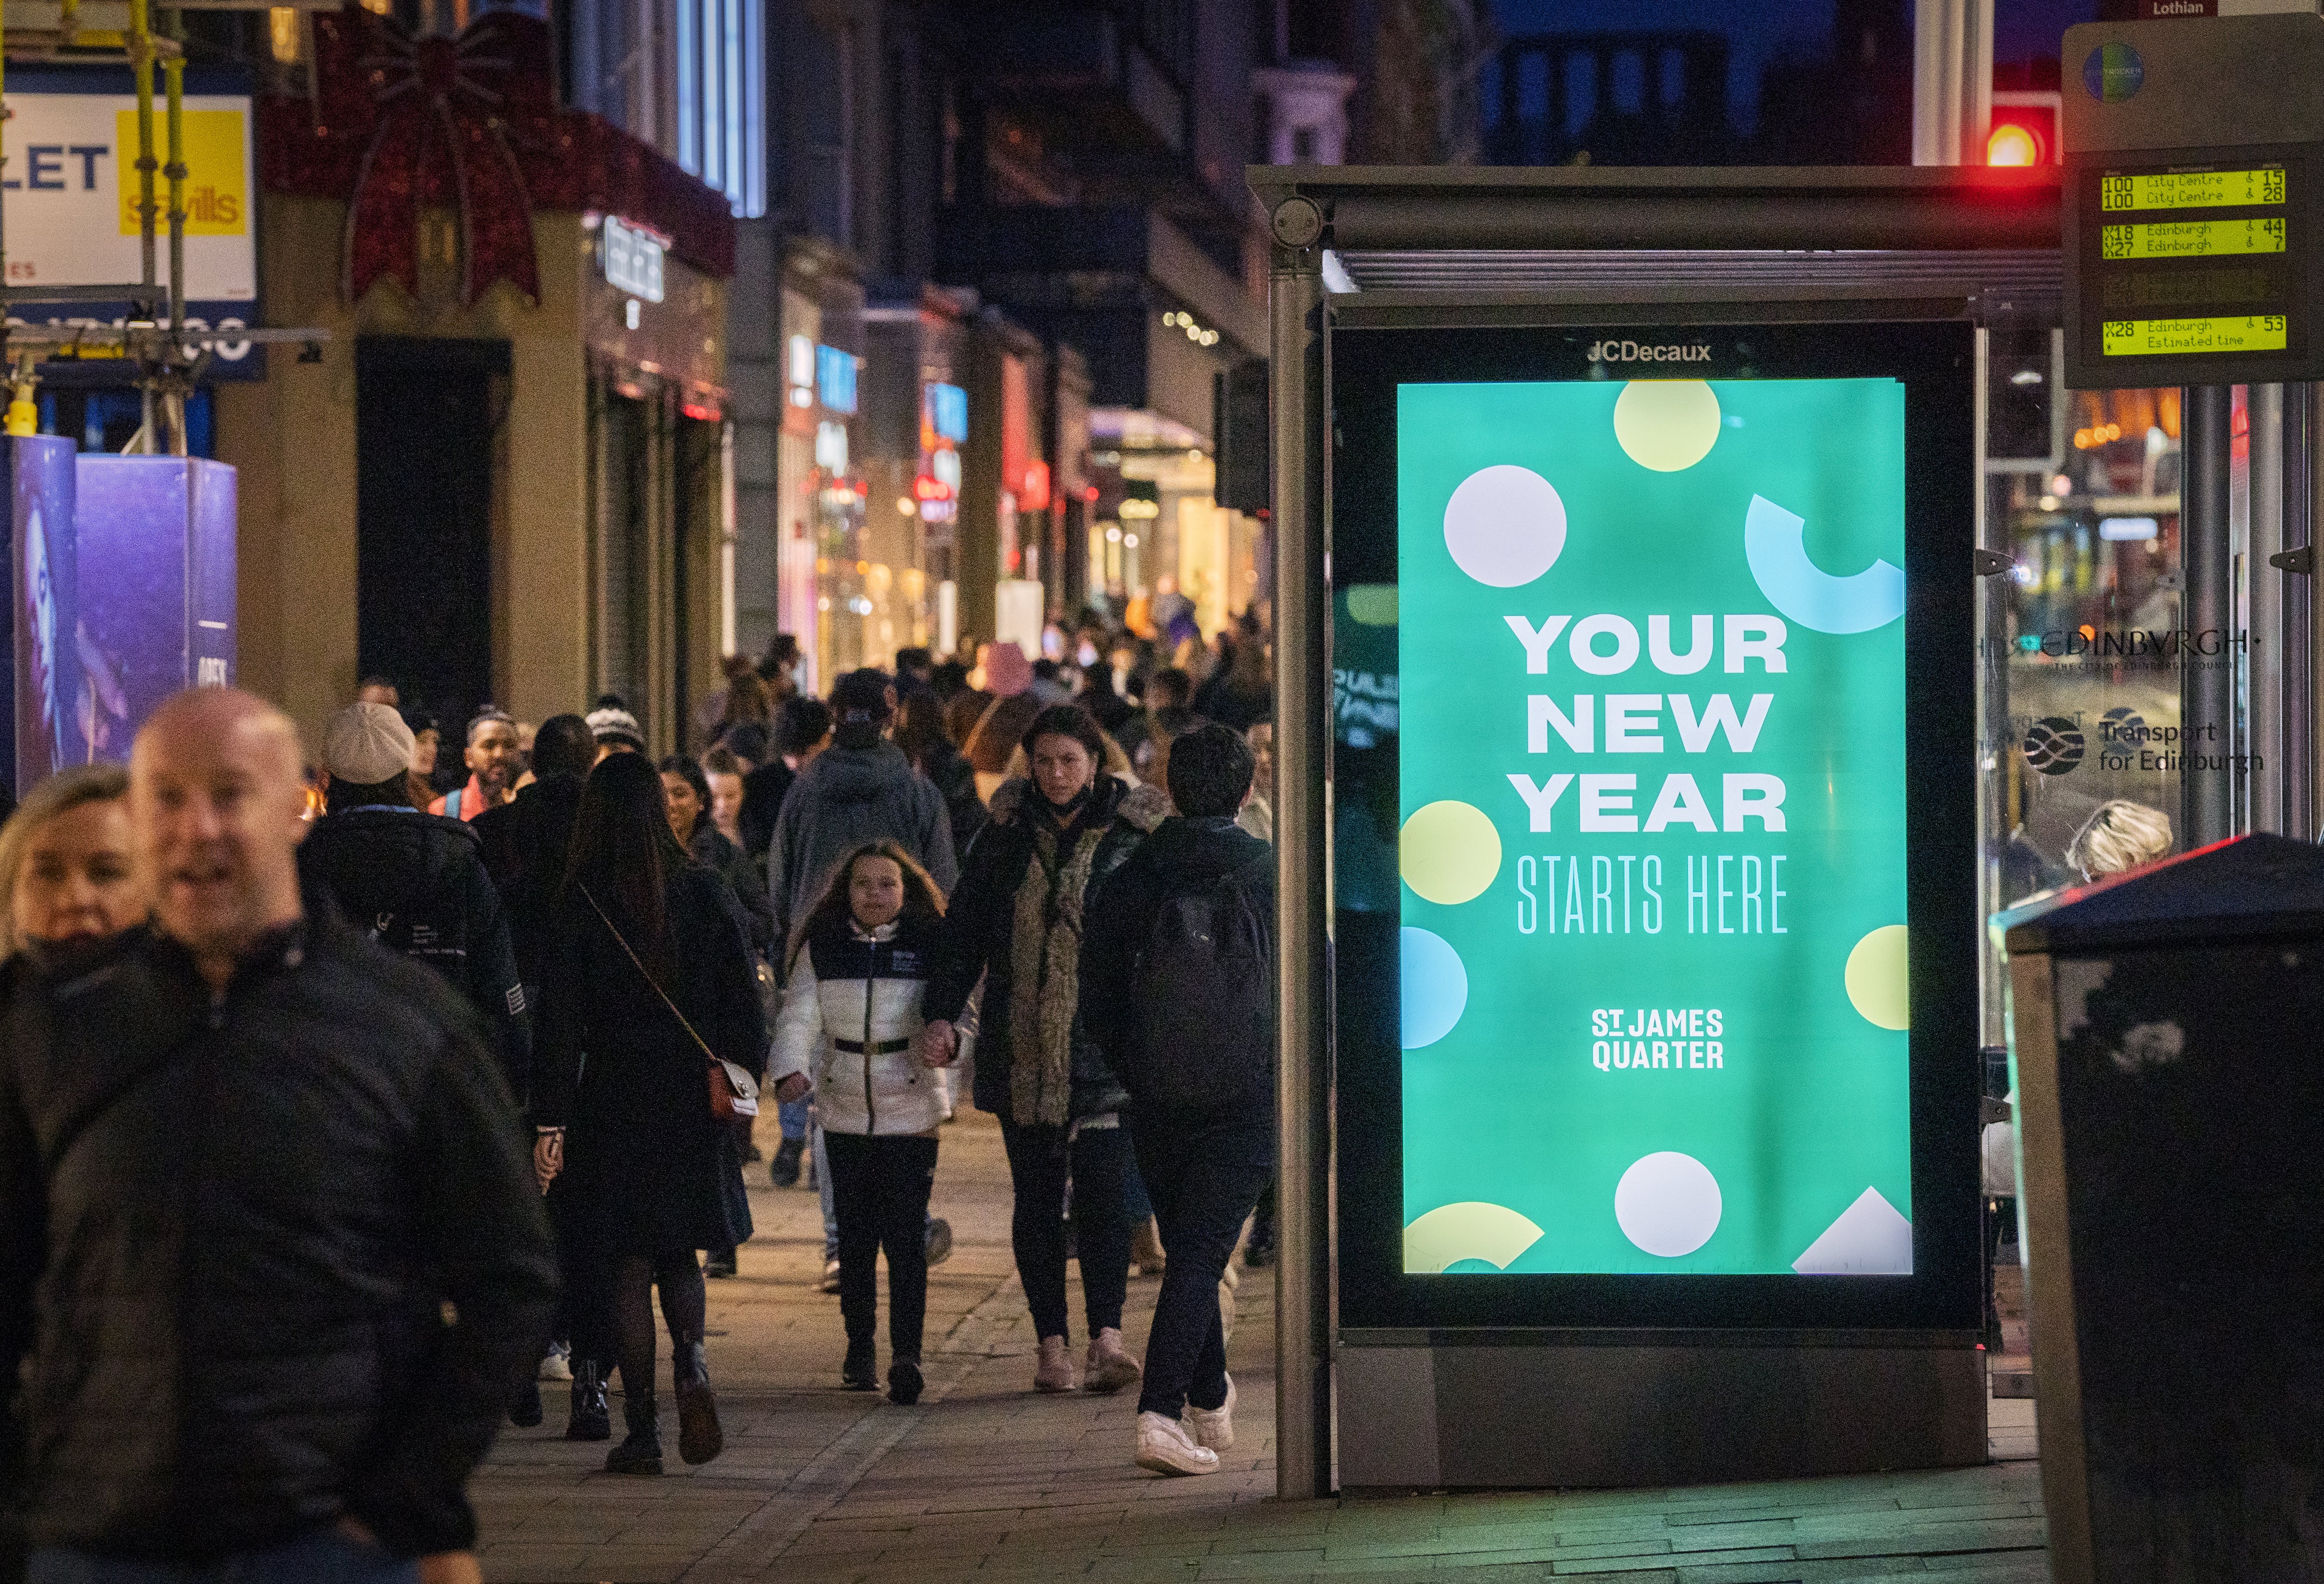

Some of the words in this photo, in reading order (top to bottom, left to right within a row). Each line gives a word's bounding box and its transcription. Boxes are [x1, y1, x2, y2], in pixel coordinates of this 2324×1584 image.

[2153, 1, 2203, 15] Lothian
[2104, 177, 2133, 193] 100
[2147, 176, 2174, 191] City
[2179, 173, 2223, 187] Centre
[2263, 171, 2283, 186] 15
[2104, 193, 2133, 209] 100
[2147, 191, 2174, 206] City
[2179, 189, 2223, 202] Centre
[2263, 187, 2283, 202] 28
[2105, 225, 2133, 241] X18
[2147, 223, 2211, 238] Edinburgh
[2263, 218, 2283, 234] 44
[2105, 242, 2133, 257] X27
[2147, 238, 2211, 253] Edinburgh
[2274, 235, 2283, 250] 7
[2105, 321, 2134, 337] X28
[2148, 319, 2212, 334] Edinburgh
[2264, 316, 2284, 332] 53
[1587, 341, 1711, 362] JCDecaux
[2148, 334, 2212, 348] Estimated
[2217, 334, 2244, 345] time
[1503, 614, 1788, 675] YOUR
[1527, 694, 1774, 753] NEW
[2100, 721, 2216, 745] Transport
[2100, 751, 2133, 770] for
[2141, 750, 2264, 775] Edinburgh
[1506, 773, 1787, 832] YEAR
[1517, 855, 1662, 934] STARTS
[1688, 855, 1788, 934] HERE
[1628, 1009, 1724, 1037] JAMES
[1592, 1040, 1724, 1072] QUARTER
